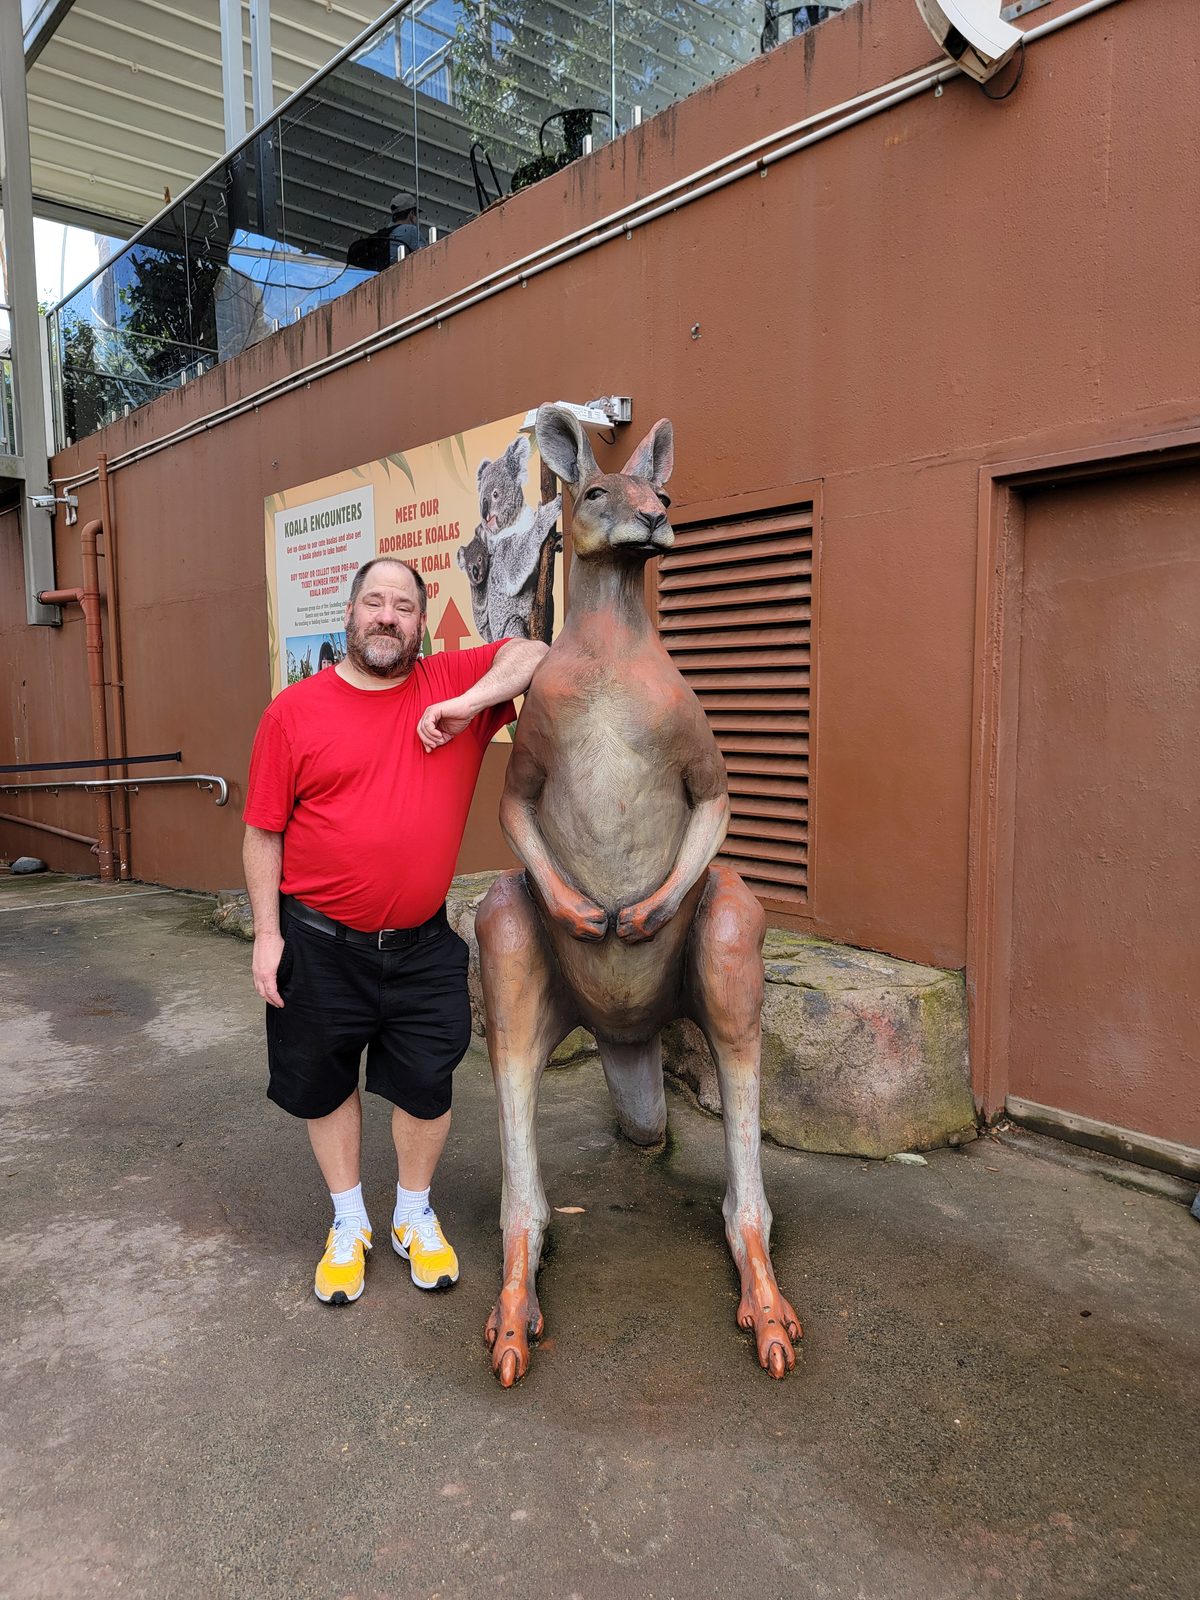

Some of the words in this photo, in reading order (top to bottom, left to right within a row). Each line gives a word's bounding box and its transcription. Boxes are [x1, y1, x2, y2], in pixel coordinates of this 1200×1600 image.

[284, 518, 308, 538] KOALA
[311, 502, 362, 531] ENCOUNTERS
[396, 504, 417, 524] MEET
[420, 498, 439, 518] OUR
[326, 537, 337, 545] koalas
[380, 530, 422, 554] ADORABLE
[426, 521, 460, 544] KOALAS
[316, 567, 330, 576] COLLECT
[330, 565, 340, 573] YOUR
[341, 562, 359, 571] PRE-PAID
[422, 553, 450, 573] KOALA
[314, 578, 328, 586] NUMBER
